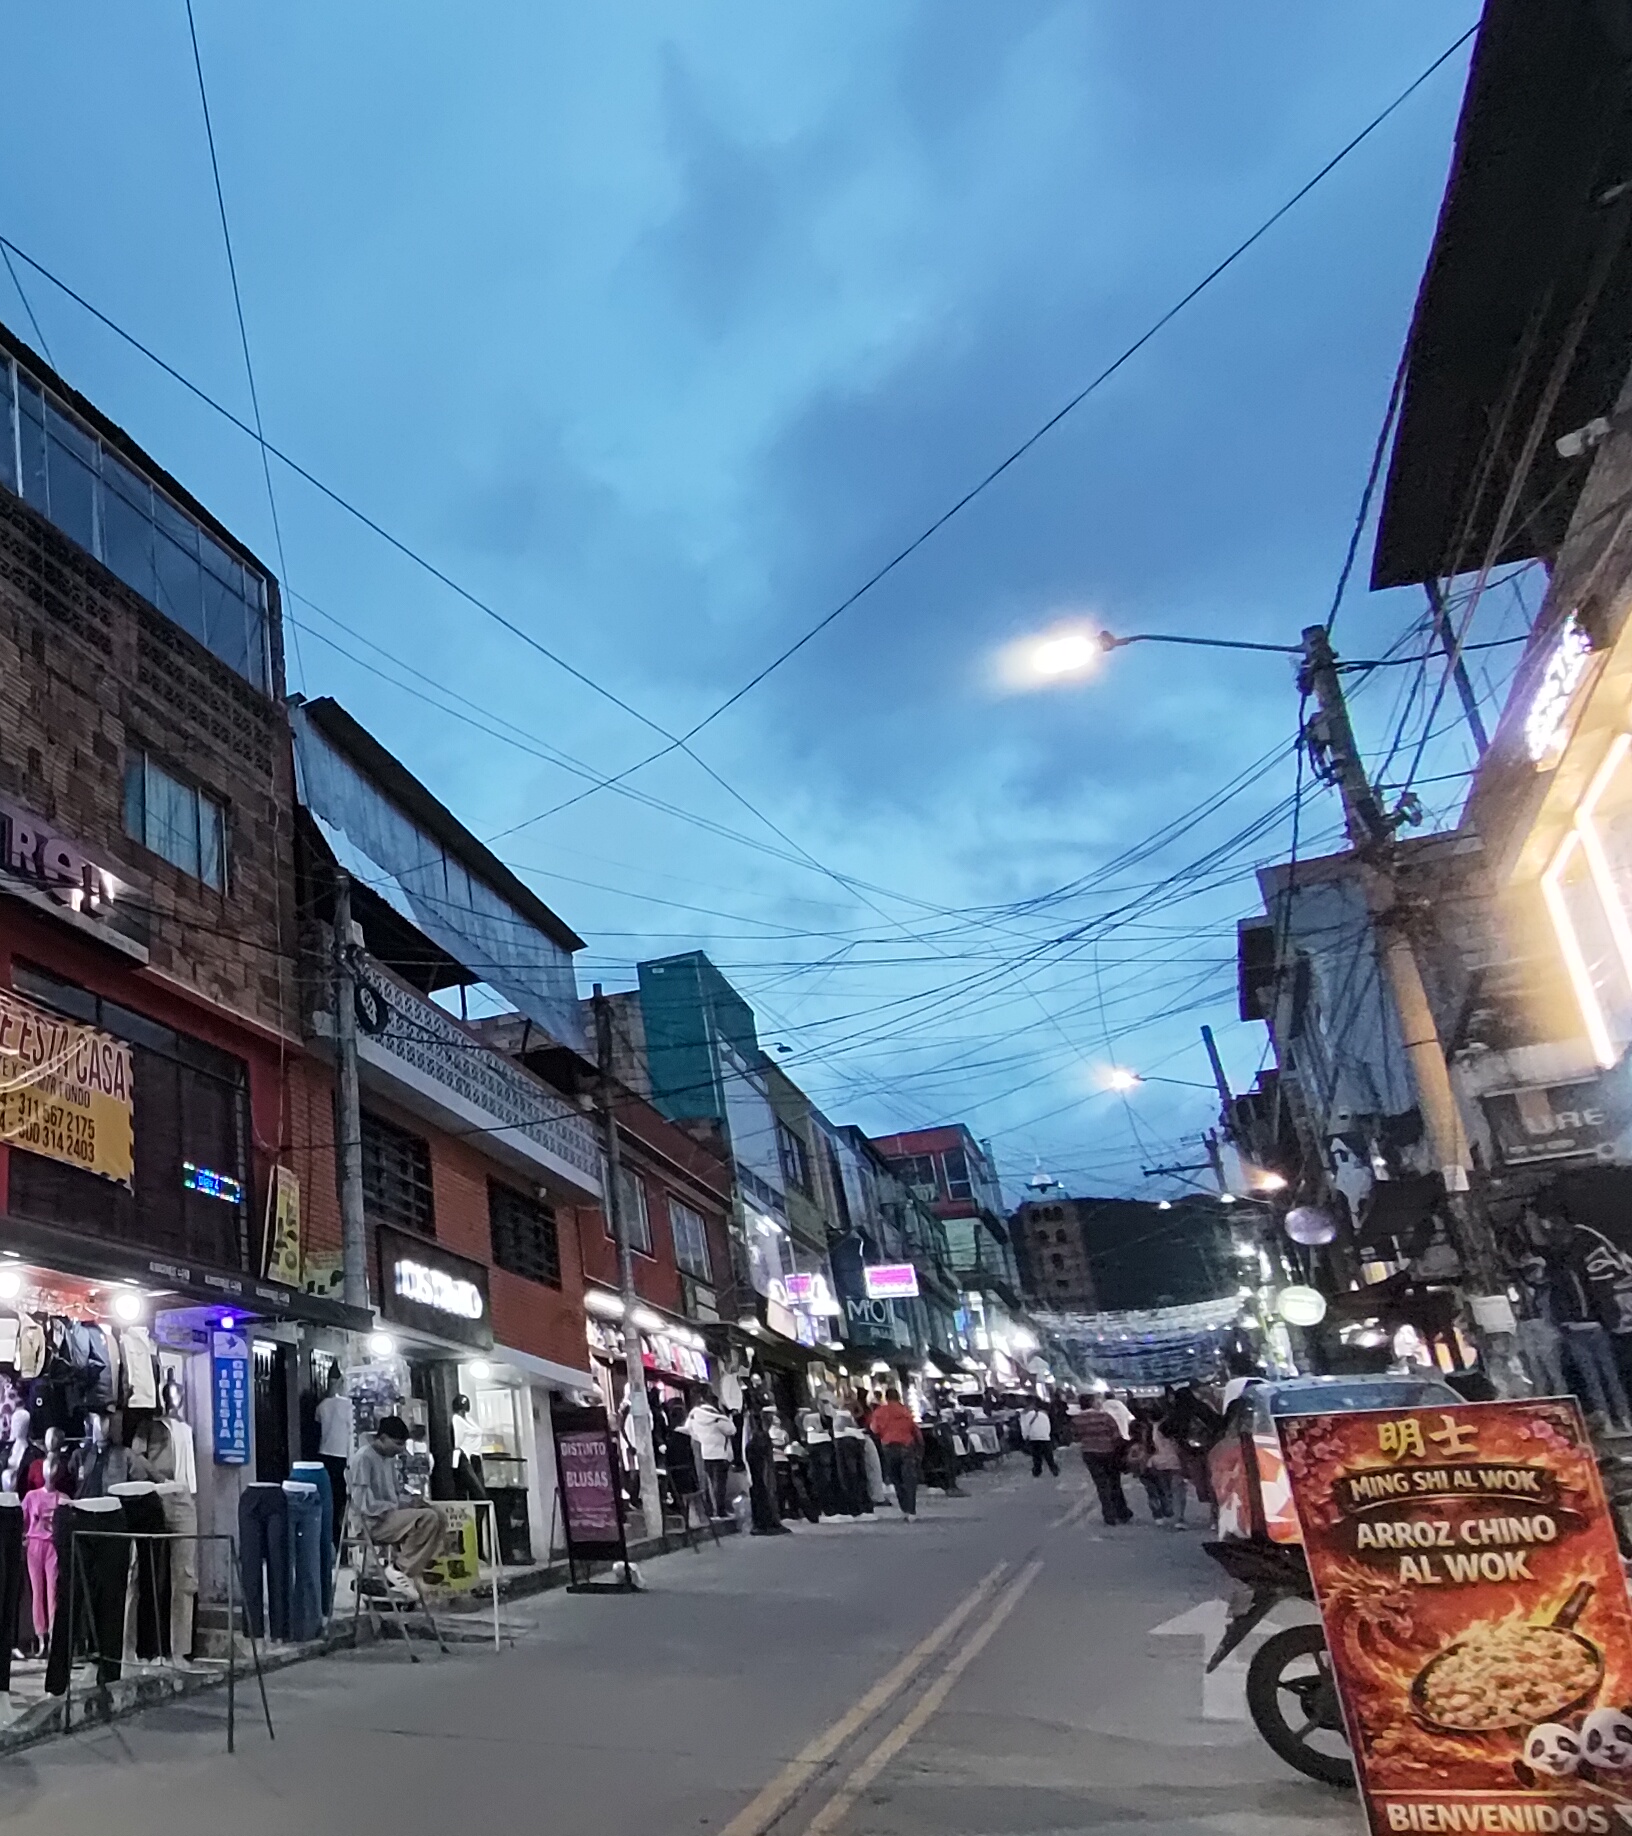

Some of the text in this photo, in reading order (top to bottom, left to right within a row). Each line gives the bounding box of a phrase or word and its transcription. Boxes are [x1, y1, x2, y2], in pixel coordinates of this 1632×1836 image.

[18, 1010, 69, 1079] ESTA
[75, 1032, 126, 1102] CASA
[18, 1092, 39, 1122] 311
[42, 1101, 65, 1128] 567
[66, 1111, 96, 1140] 2175
[42, 1126, 64, 1152] 314
[66, 1131, 95, 1163] 2403
[1377, 1413, 1480, 1461] 明士
[566, 1470, 609, 1488] BLUSAS
[1350, 1469, 1541, 1502] MING SHI AL WOK
[1357, 1514, 1557, 1549] ARROZ CHINO
[1399, 1550, 1539, 1585] AL WOK
[1385, 1802, 1610, 1835] BIENVENIDOS
